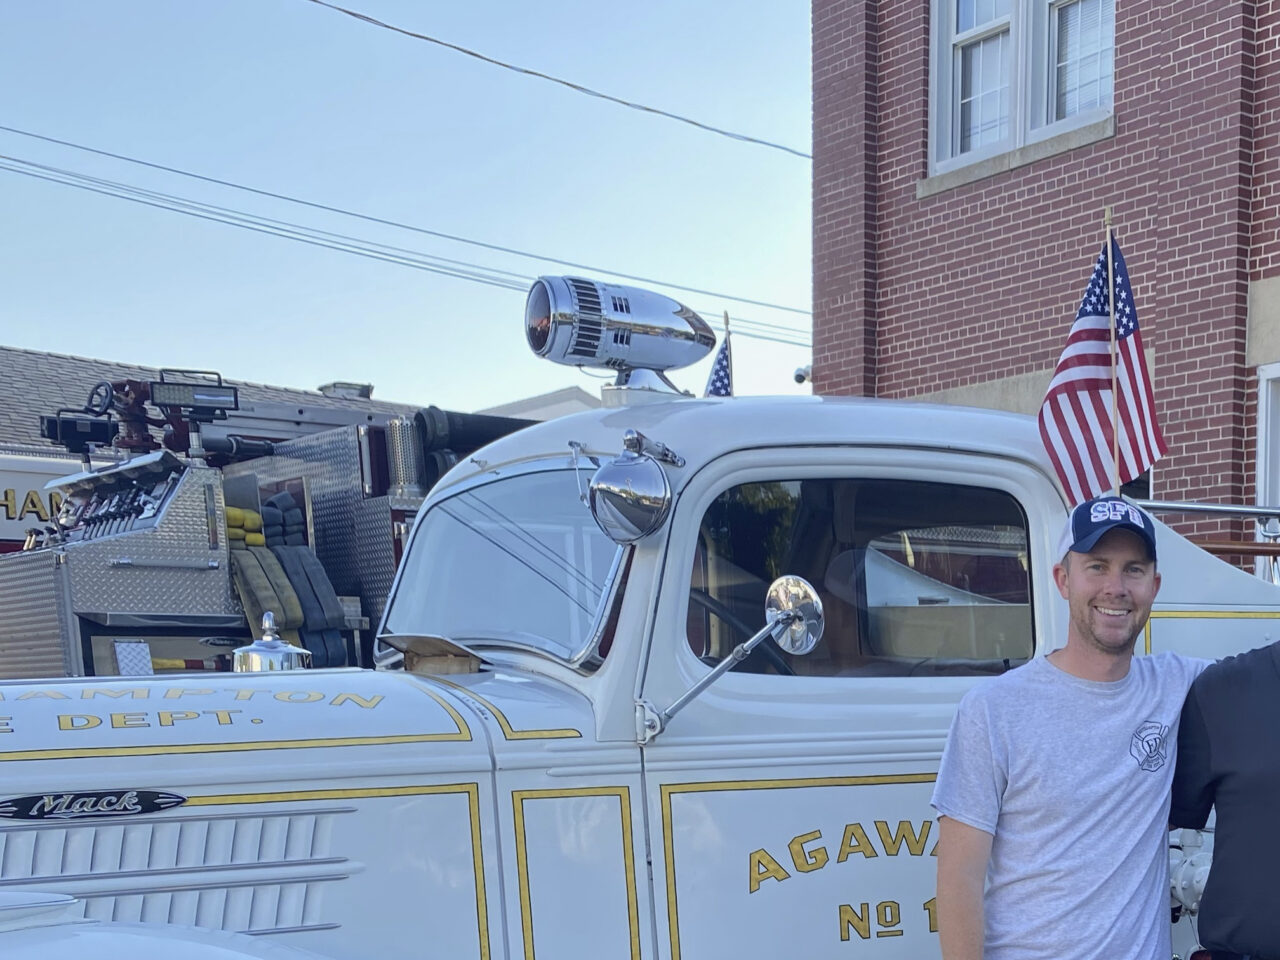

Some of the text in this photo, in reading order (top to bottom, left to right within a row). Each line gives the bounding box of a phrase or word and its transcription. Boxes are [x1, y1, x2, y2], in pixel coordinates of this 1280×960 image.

[0, 688, 385, 709] AMPTON
[57, 709, 264, 731] DEPT.
[29, 791, 142, 818] Mack
[749, 820, 939, 894] AGAW
